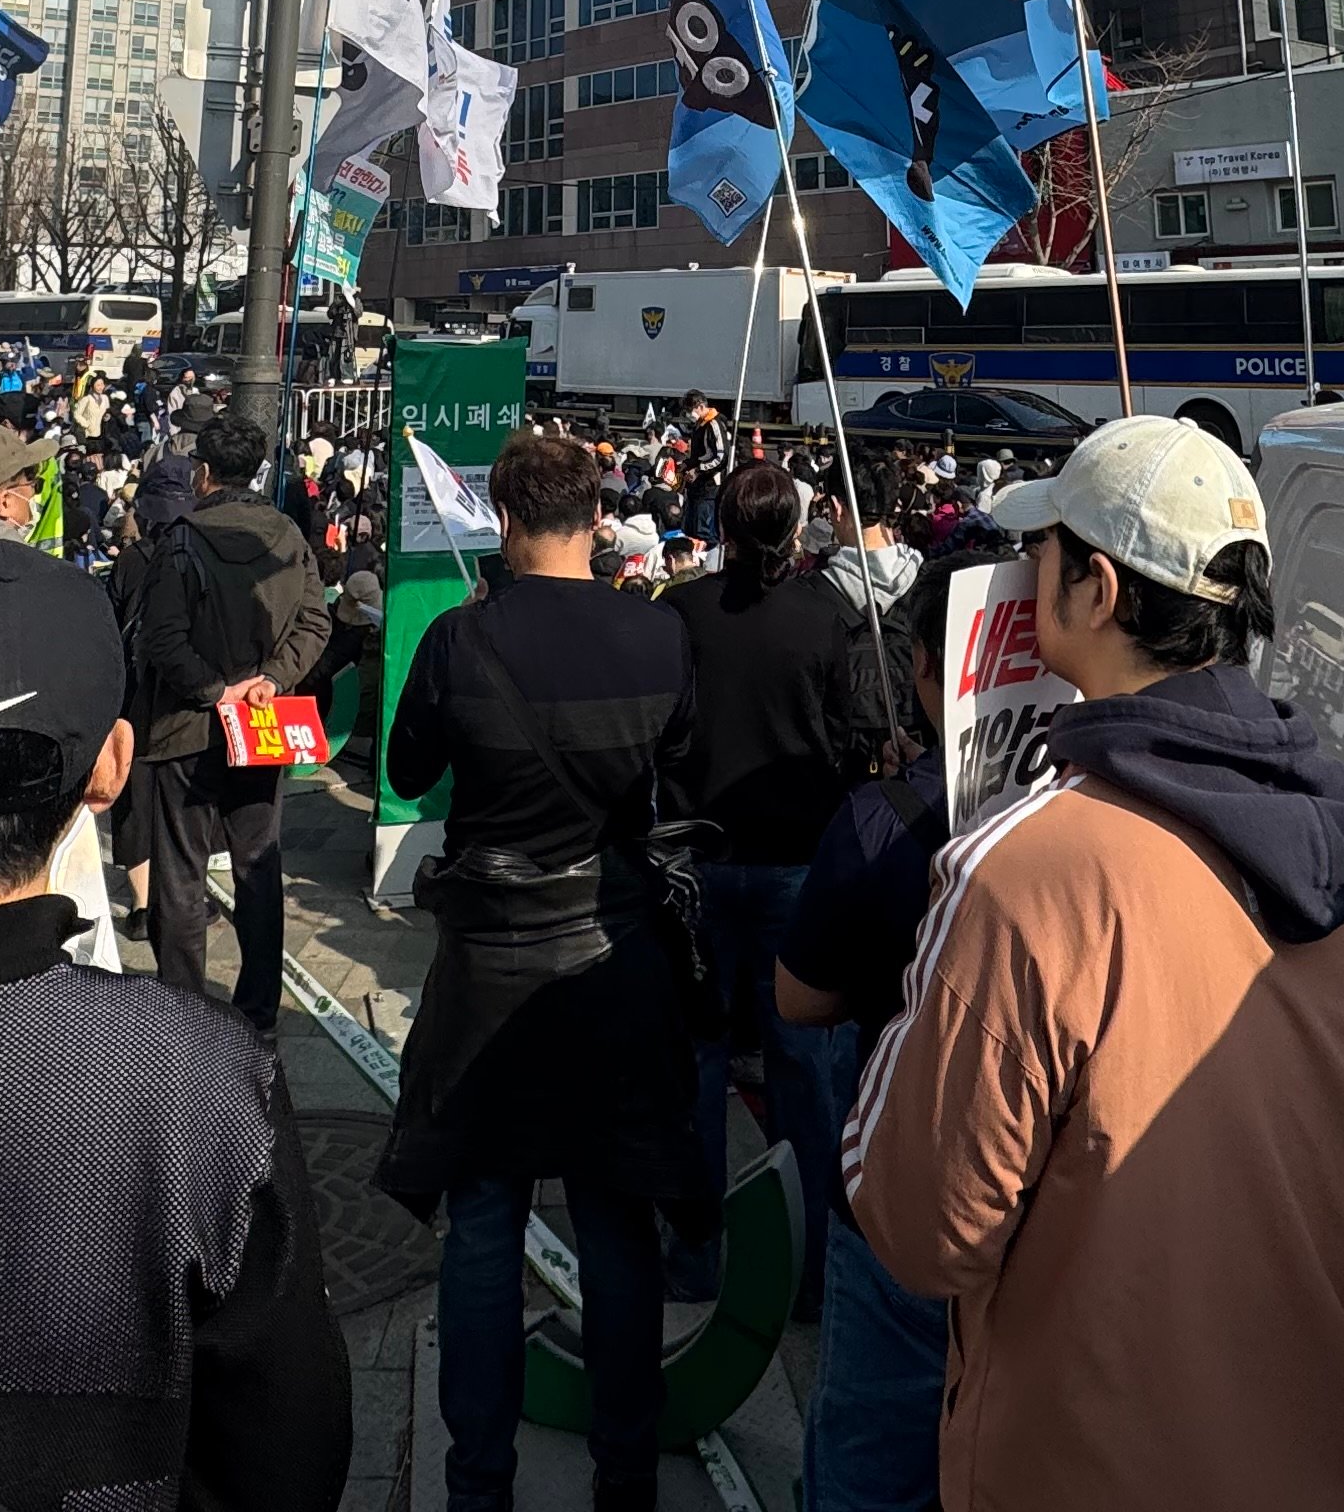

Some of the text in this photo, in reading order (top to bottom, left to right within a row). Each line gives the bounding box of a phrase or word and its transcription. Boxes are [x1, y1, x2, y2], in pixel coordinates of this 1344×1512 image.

[1199, 151, 1280, 166] Top Travel Korea
[879, 355, 912, 372] 경찰
[1235, 357, 1307, 376] POLICE
[401, 401, 522, 432] 임시폐쇄
